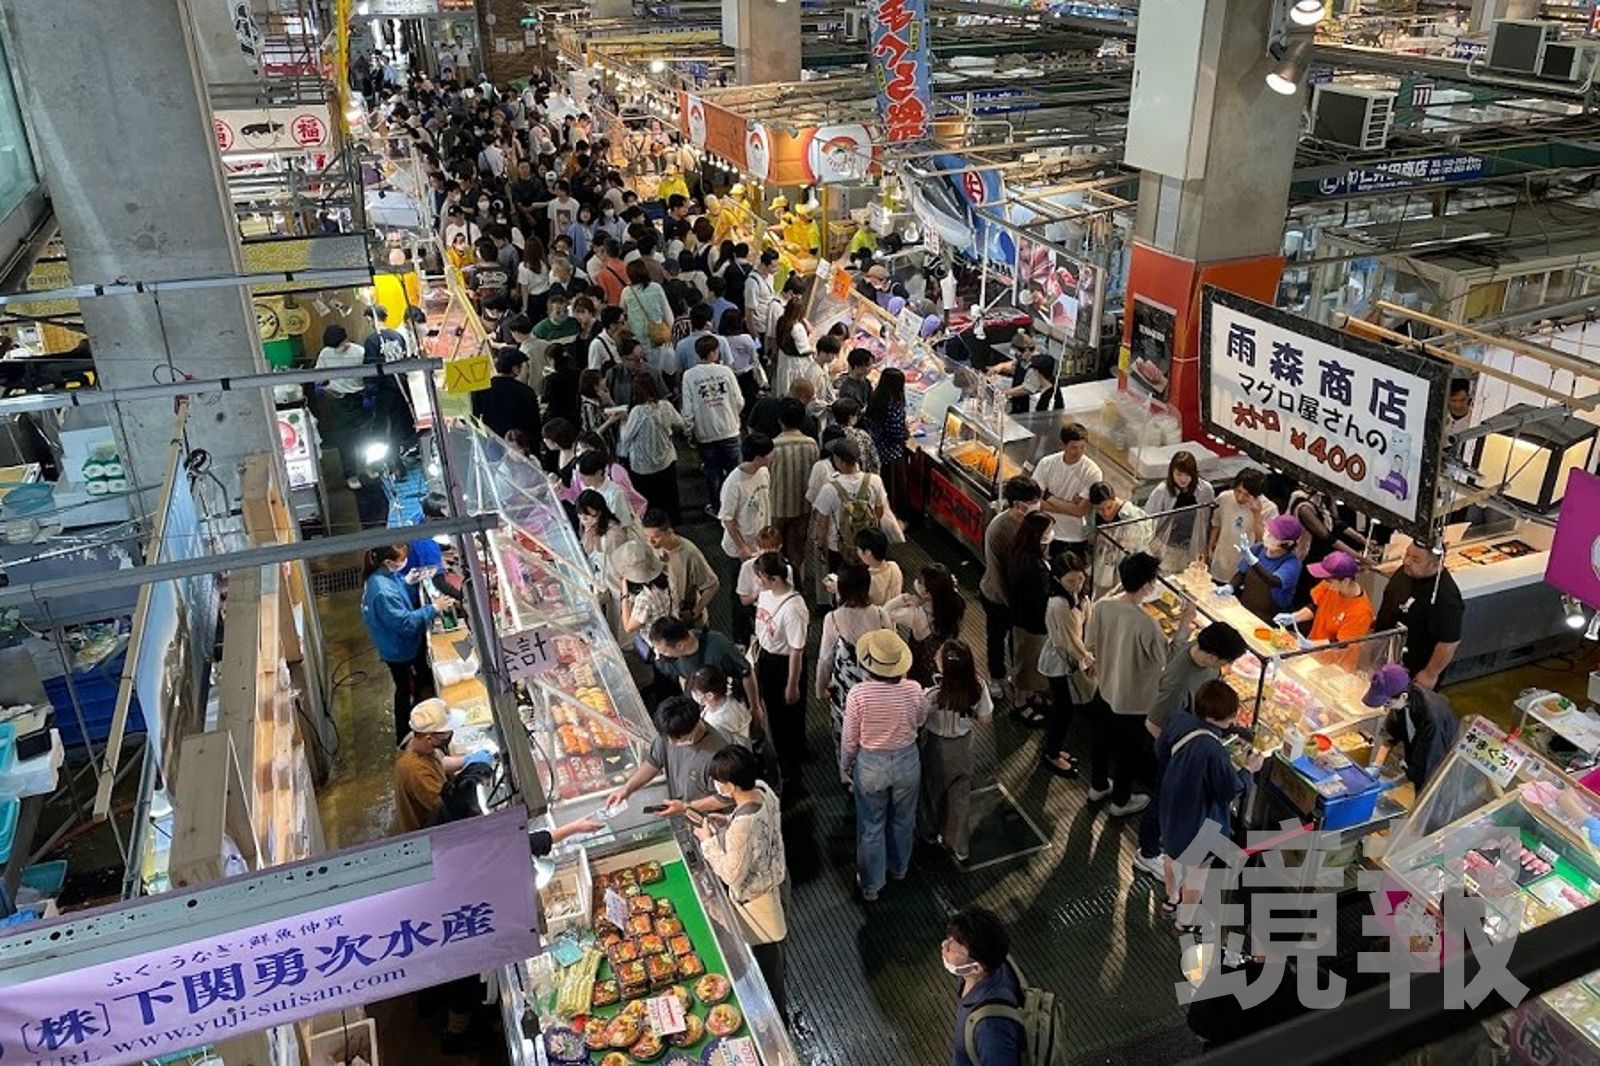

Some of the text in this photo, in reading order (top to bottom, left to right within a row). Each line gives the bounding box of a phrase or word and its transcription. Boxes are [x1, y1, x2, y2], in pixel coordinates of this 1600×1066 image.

[452, 360, 488, 391] 入口
[1227, 322, 1410, 431] 雨森商店
[1231, 401, 1281, 432] 大トロ
[1238, 371, 1388, 456] マグロ屋さんの
[112, 966, 407, 1054] www.yuji-suisan.com
